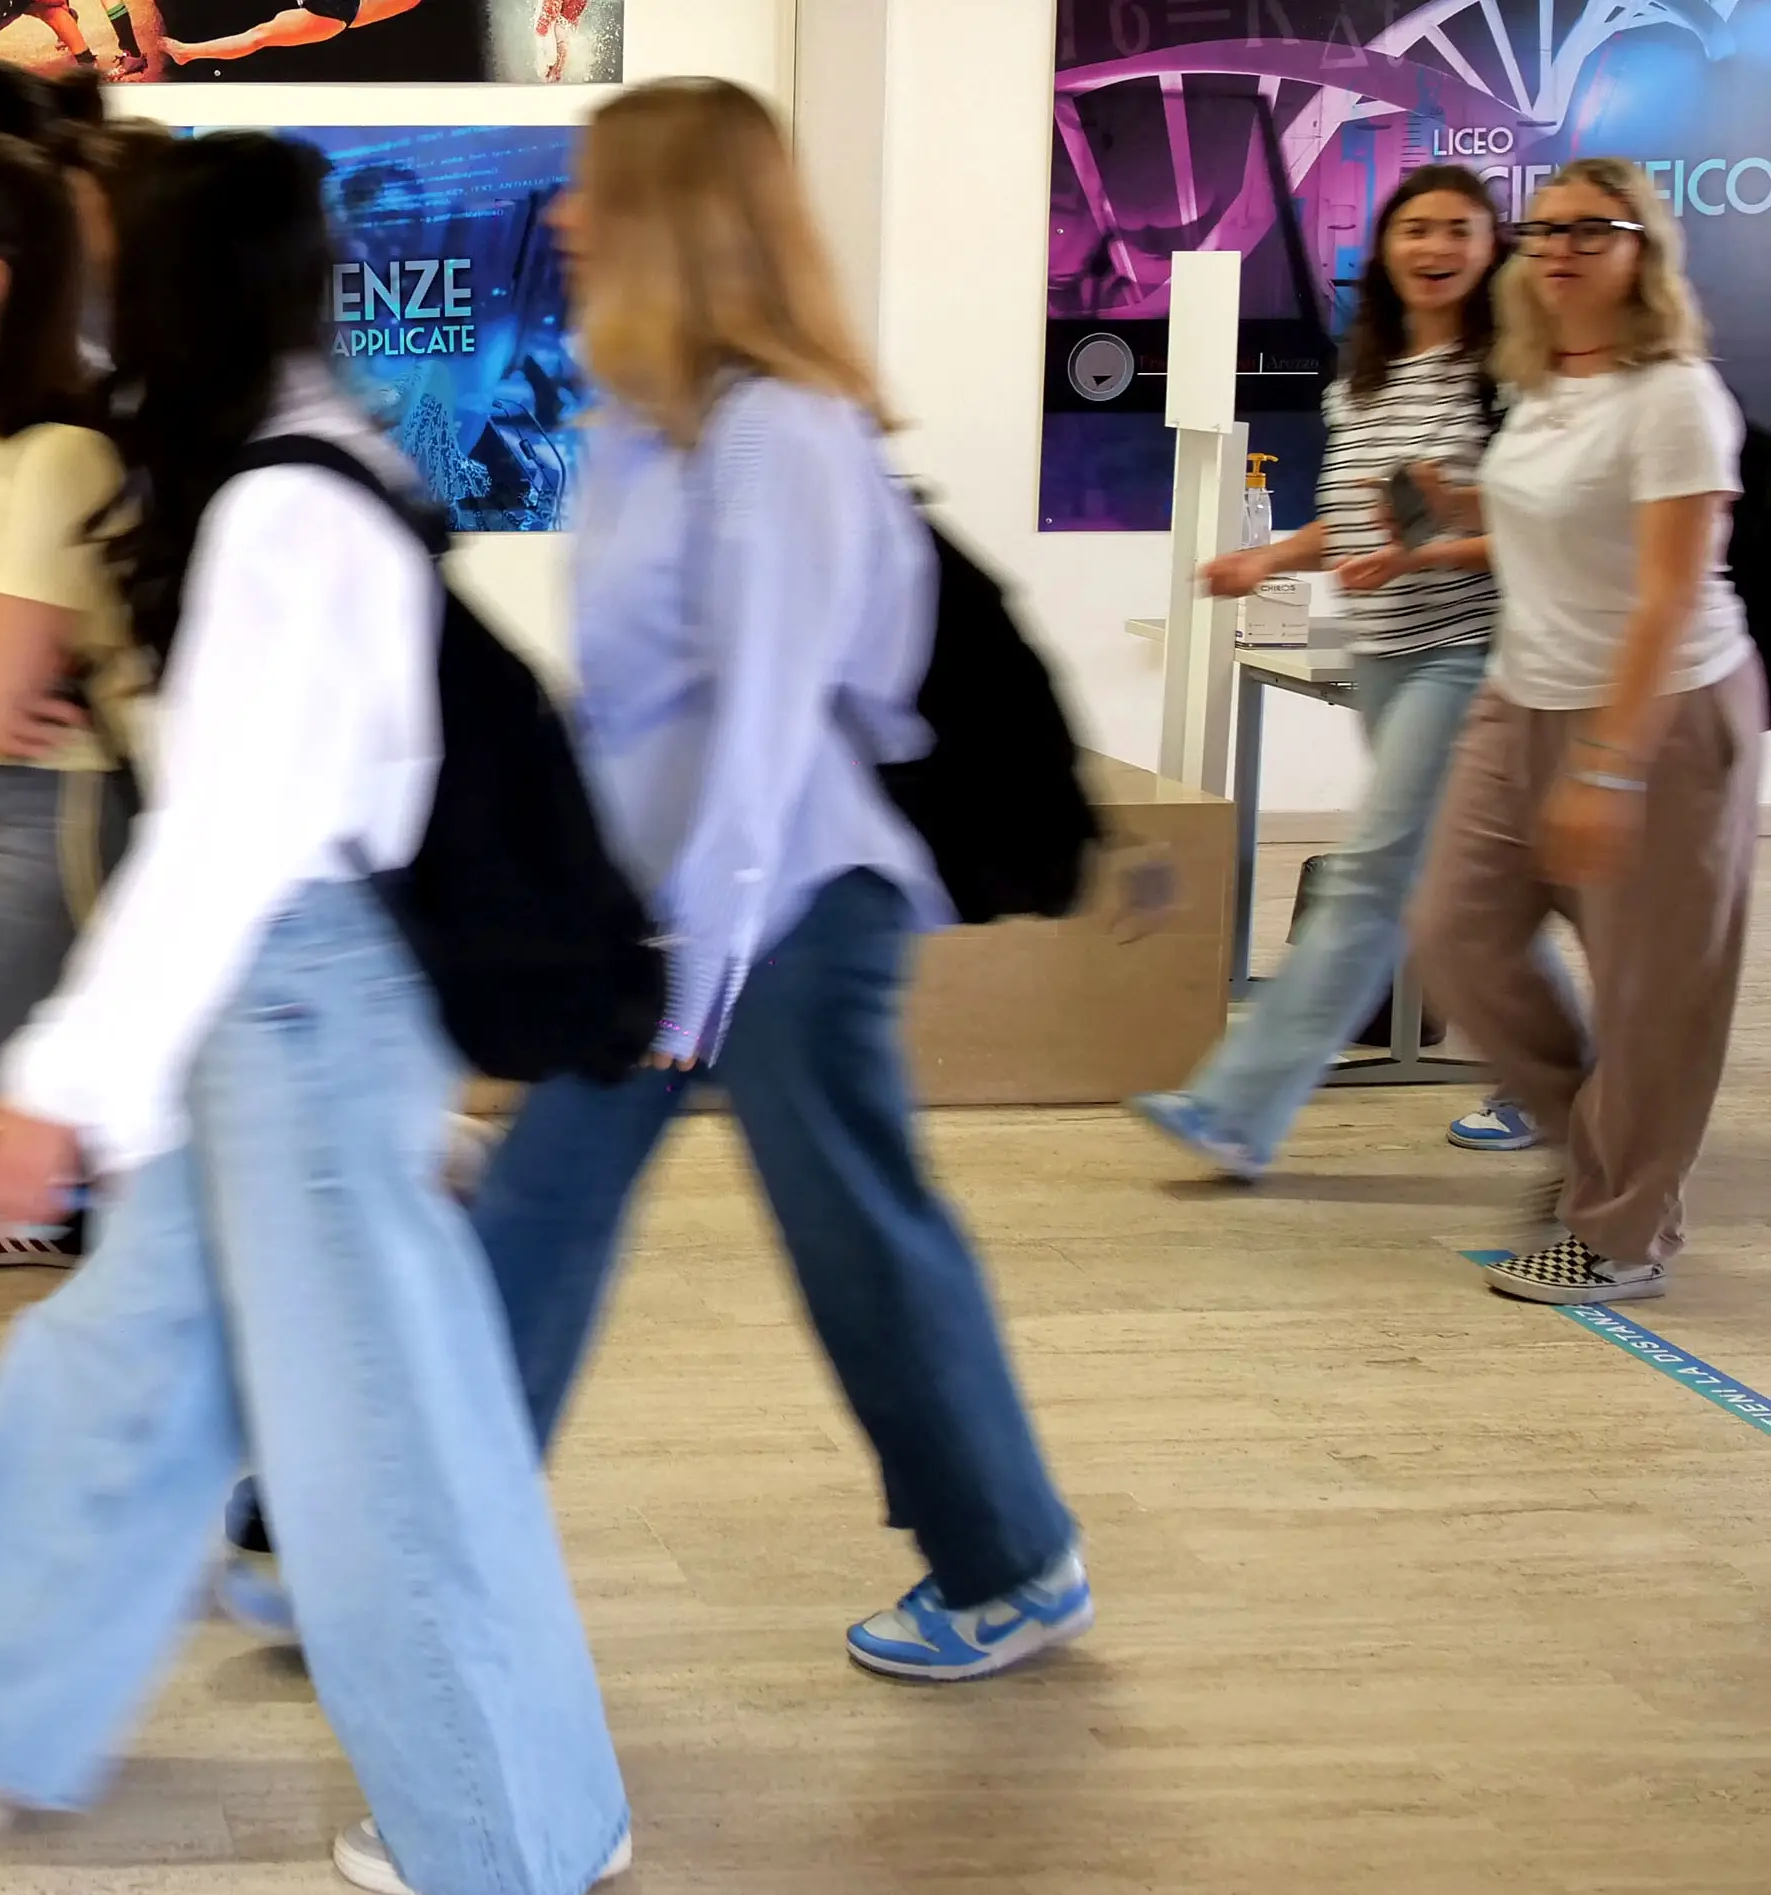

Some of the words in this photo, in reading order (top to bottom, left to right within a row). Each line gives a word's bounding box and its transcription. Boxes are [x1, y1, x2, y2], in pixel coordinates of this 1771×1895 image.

[1433, 127, 1514, 156] LICEO
[332, 259, 472, 322] ENZE
[332, 324, 475, 357] APPLICATE
[1565, 1304, 1684, 1363] DISTANZ
[1676, 1366, 1721, 1384] LA
